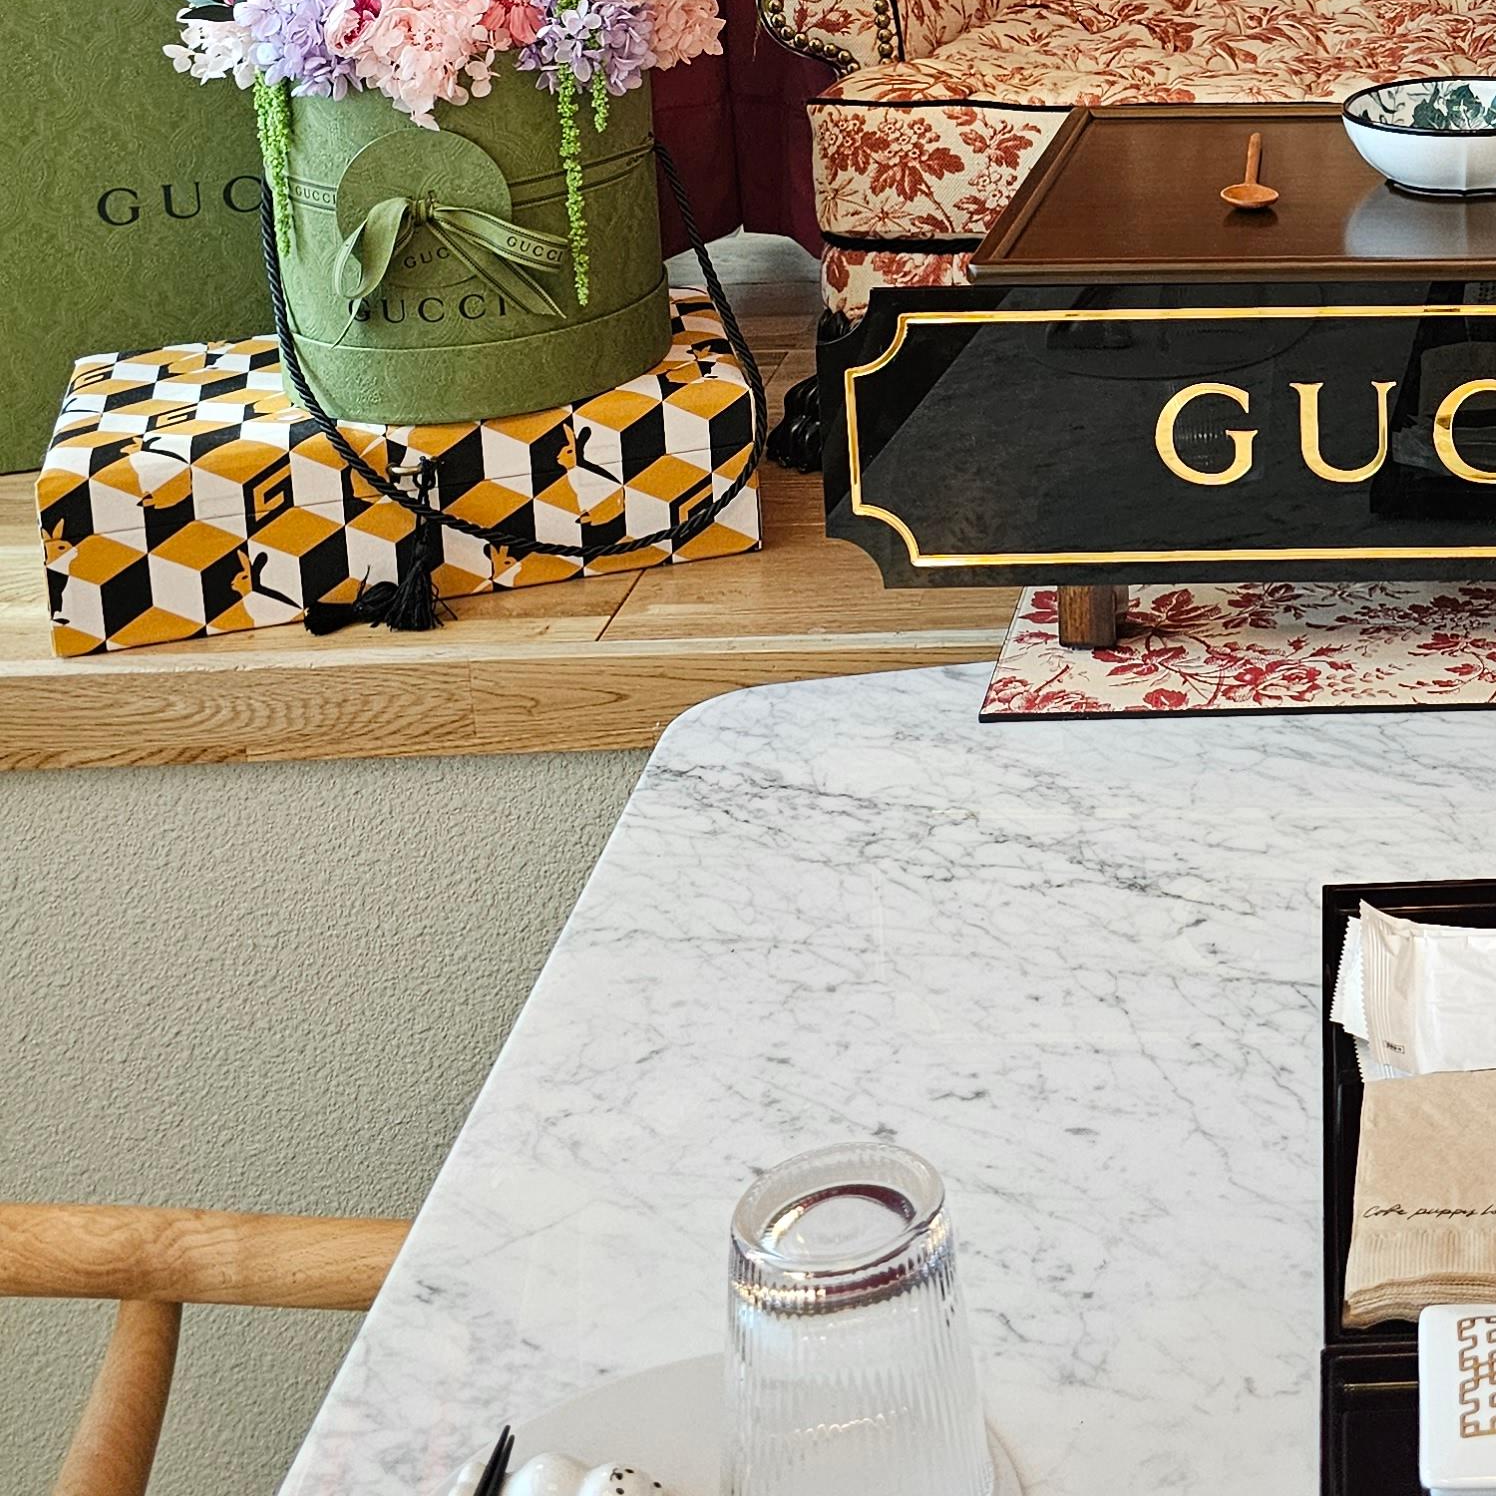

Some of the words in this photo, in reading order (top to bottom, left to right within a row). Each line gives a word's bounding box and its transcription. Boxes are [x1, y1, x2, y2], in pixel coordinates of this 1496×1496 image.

[97, 175, 266, 226] GUC
[295, 185, 336, 204] GUCCI
[403, 247, 450, 269] GUC
[505, 236, 563, 263] GUCCI
[348, 293, 507, 324] GUCCI
[1407, 1205, 1479, 1221] puppy
